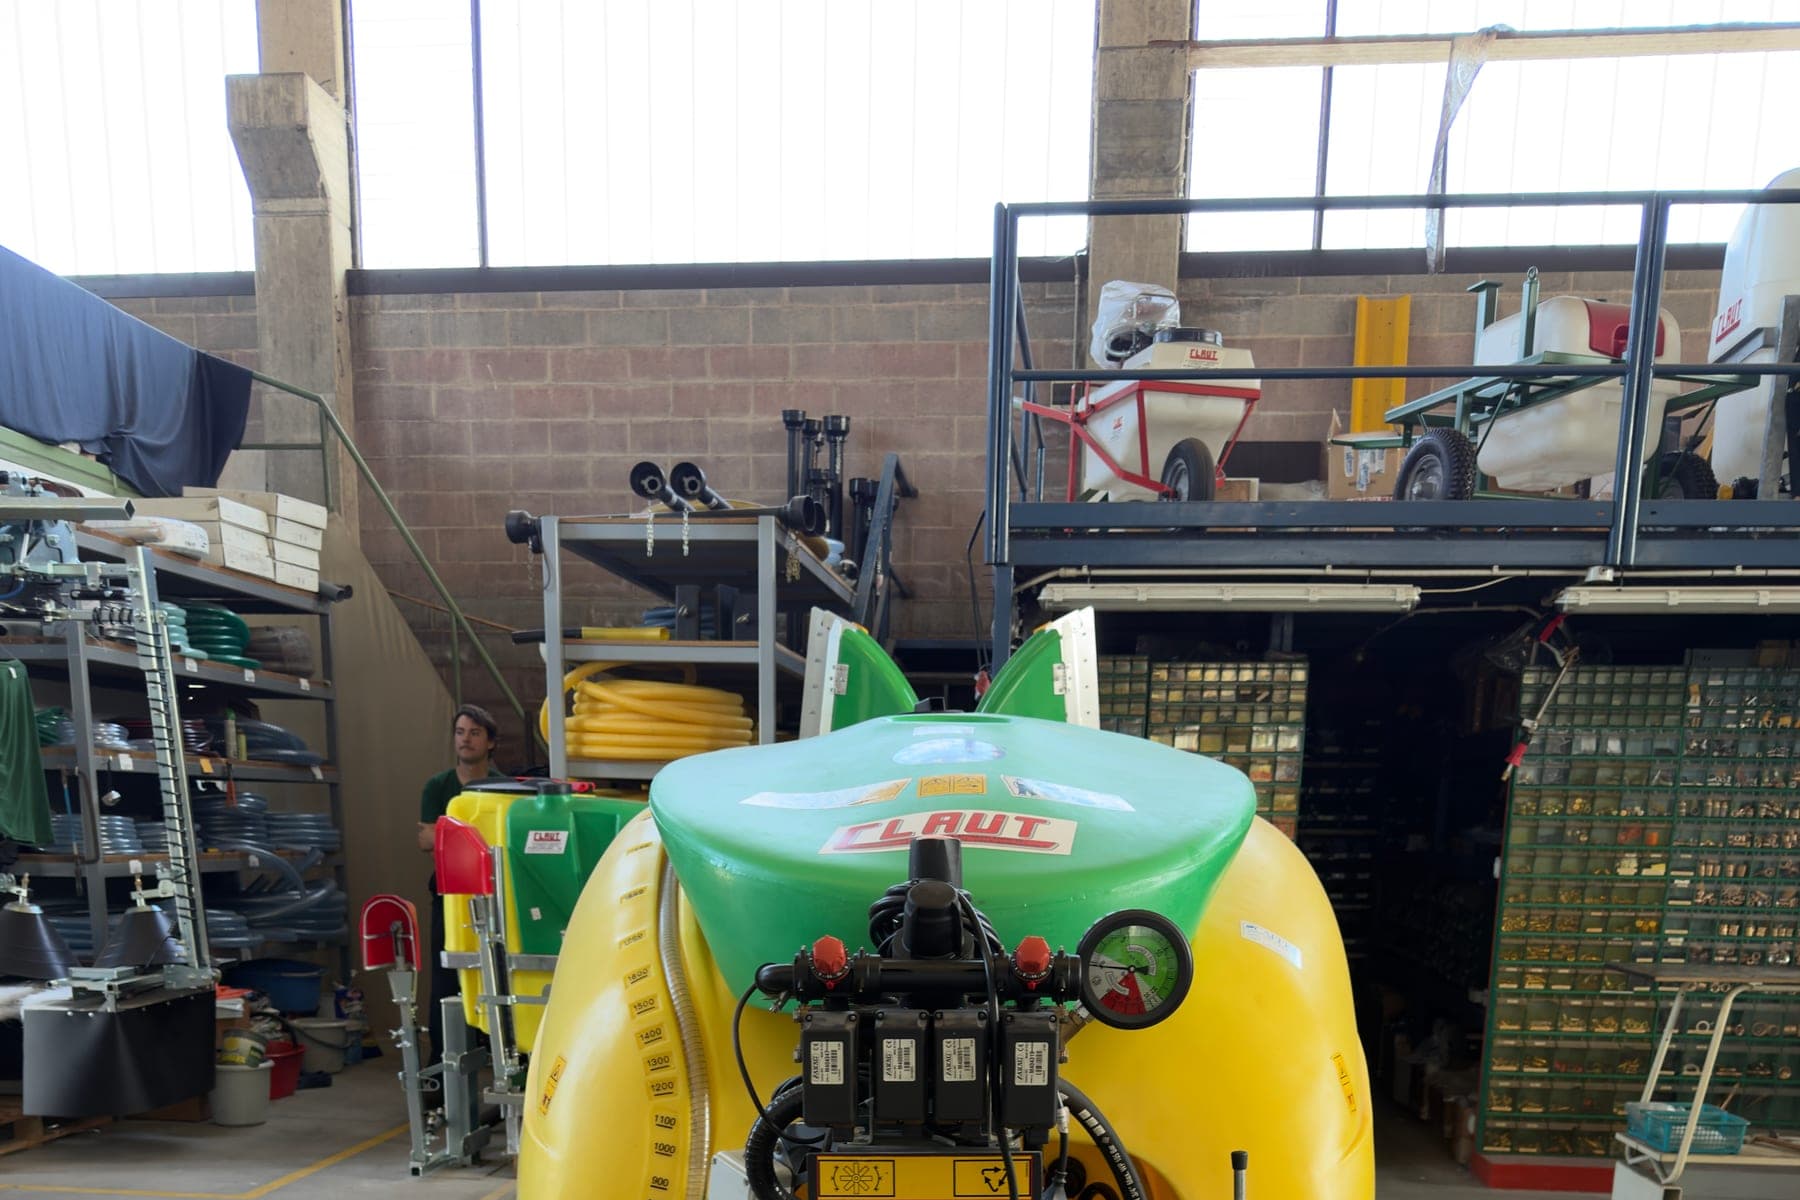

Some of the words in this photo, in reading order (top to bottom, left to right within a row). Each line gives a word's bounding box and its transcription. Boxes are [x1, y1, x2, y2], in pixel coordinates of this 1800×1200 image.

[1190, 349, 1218, 361] CLAUT
[834, 811, 1060, 850] CLAUT
[534, 832, 561, 842] CLAUT
[634, 998, 655, 1011] 1500
[640, 1027, 662, 1041] 1400
[647, 1055, 670, 1067] 1300
[651, 1081, 674, 1091] 1200
[654, 1114, 676, 1127] 1100
[654, 1142, 676, 1154] 1000
[651, 1176, 669, 1187] 900
